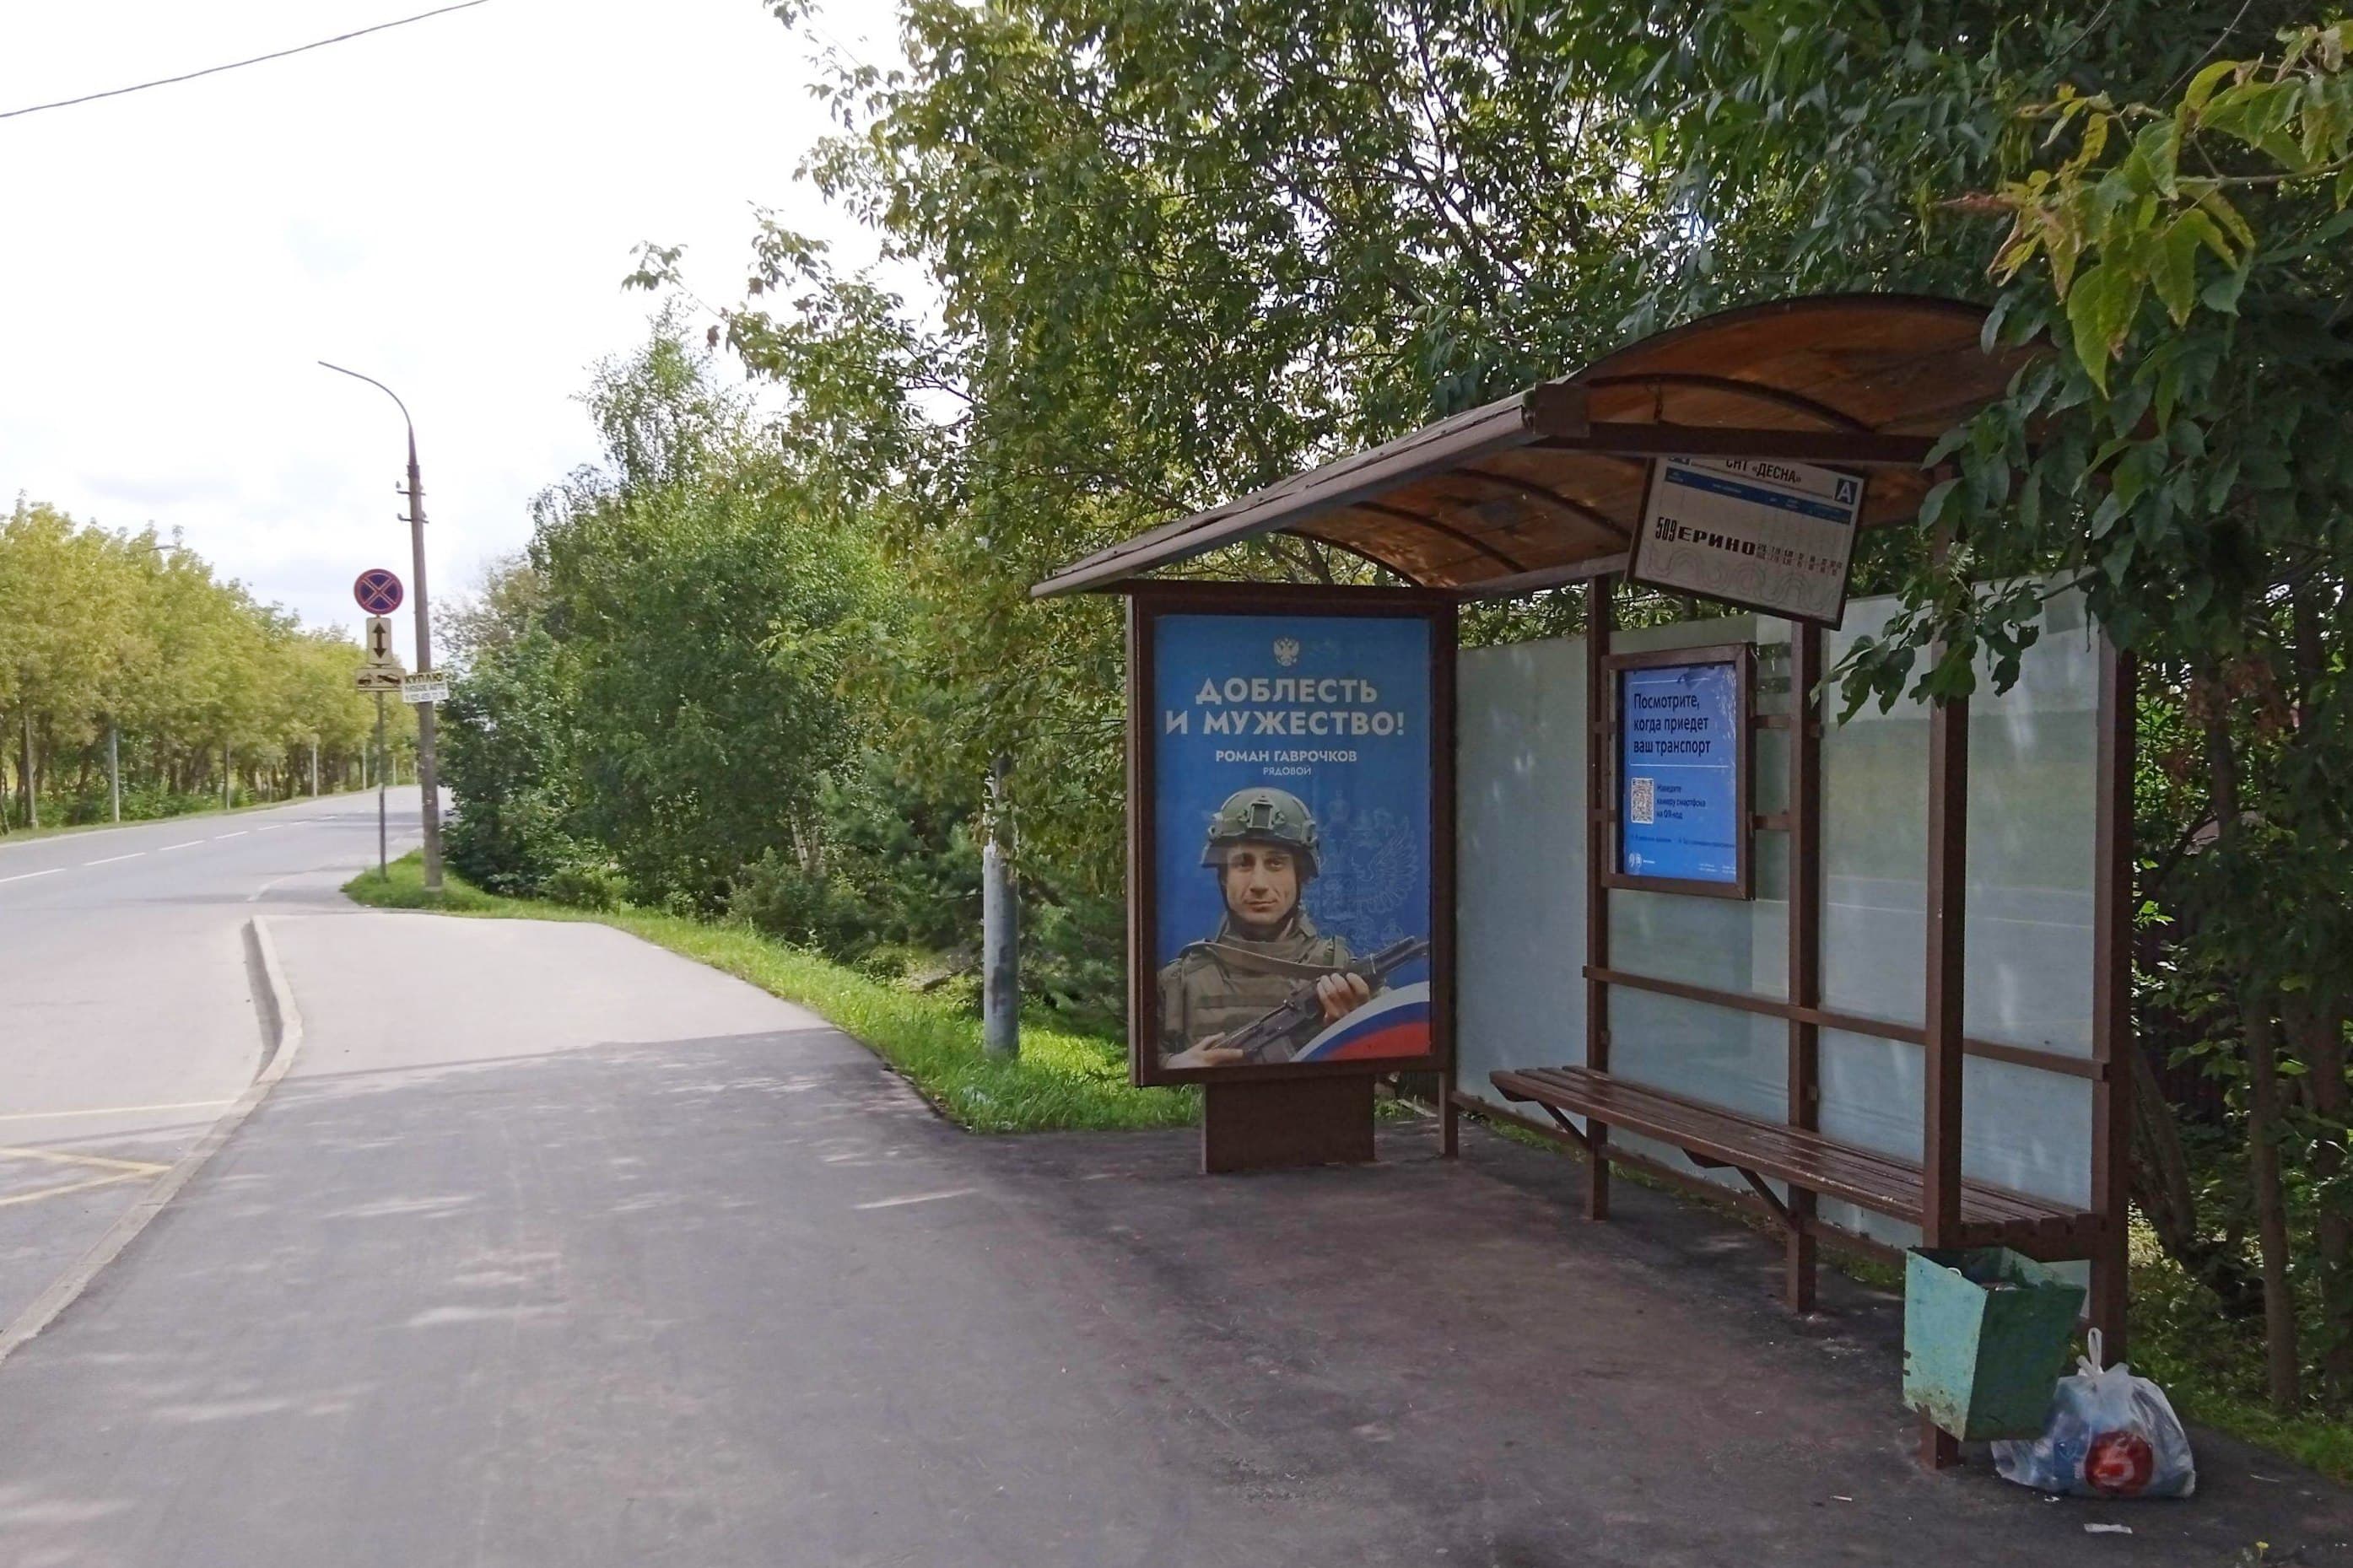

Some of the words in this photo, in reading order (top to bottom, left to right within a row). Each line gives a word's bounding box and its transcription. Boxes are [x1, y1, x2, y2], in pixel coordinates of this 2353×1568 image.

[1751, 463, 1802, 484] «ДЕСНА»
[1655, 516, 1677, 542] 509
[1678, 525, 1756, 556] ЕРИНО
[405, 672, 443, 685] КУПЛЮ
[1195, 677, 1379, 705] ДОБЛЕСТЬ
[1633, 693, 1700, 712] Посмотрите,
[1165, 709, 1189, 736] И
[1202, 711, 1405, 736] МУЖЕСТВО!
[1633, 719, 1661, 734] когда
[1664, 717, 1709, 734] приедет
[1215, 750, 1270, 762] РОМАН
[1274, 750, 1357, 762] ГАВРОЧКОВ
[1633, 741, 1654, 753] ваш
[1655, 741, 1712, 757] транспорт
[1262, 764, 1312, 776] РЯДОВОЙ
